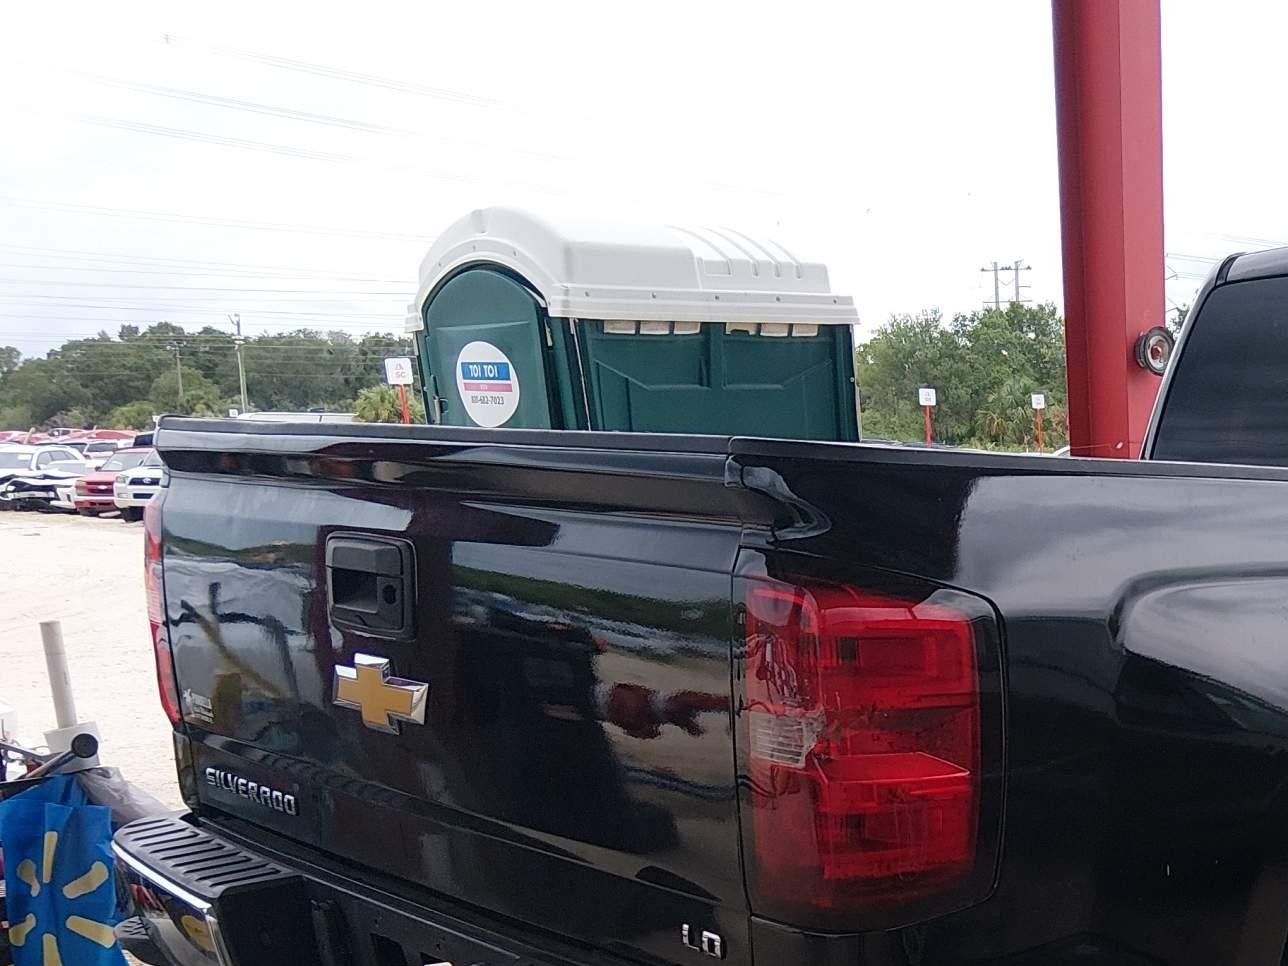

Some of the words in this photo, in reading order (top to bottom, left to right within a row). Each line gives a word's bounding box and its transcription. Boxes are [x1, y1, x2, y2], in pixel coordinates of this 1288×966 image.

[468, 364, 481, 378] TOI
[482, 364, 498, 378] TOI
[205, 766, 297, 816] SILVERADO
[682, 923, 722, 959] LD
